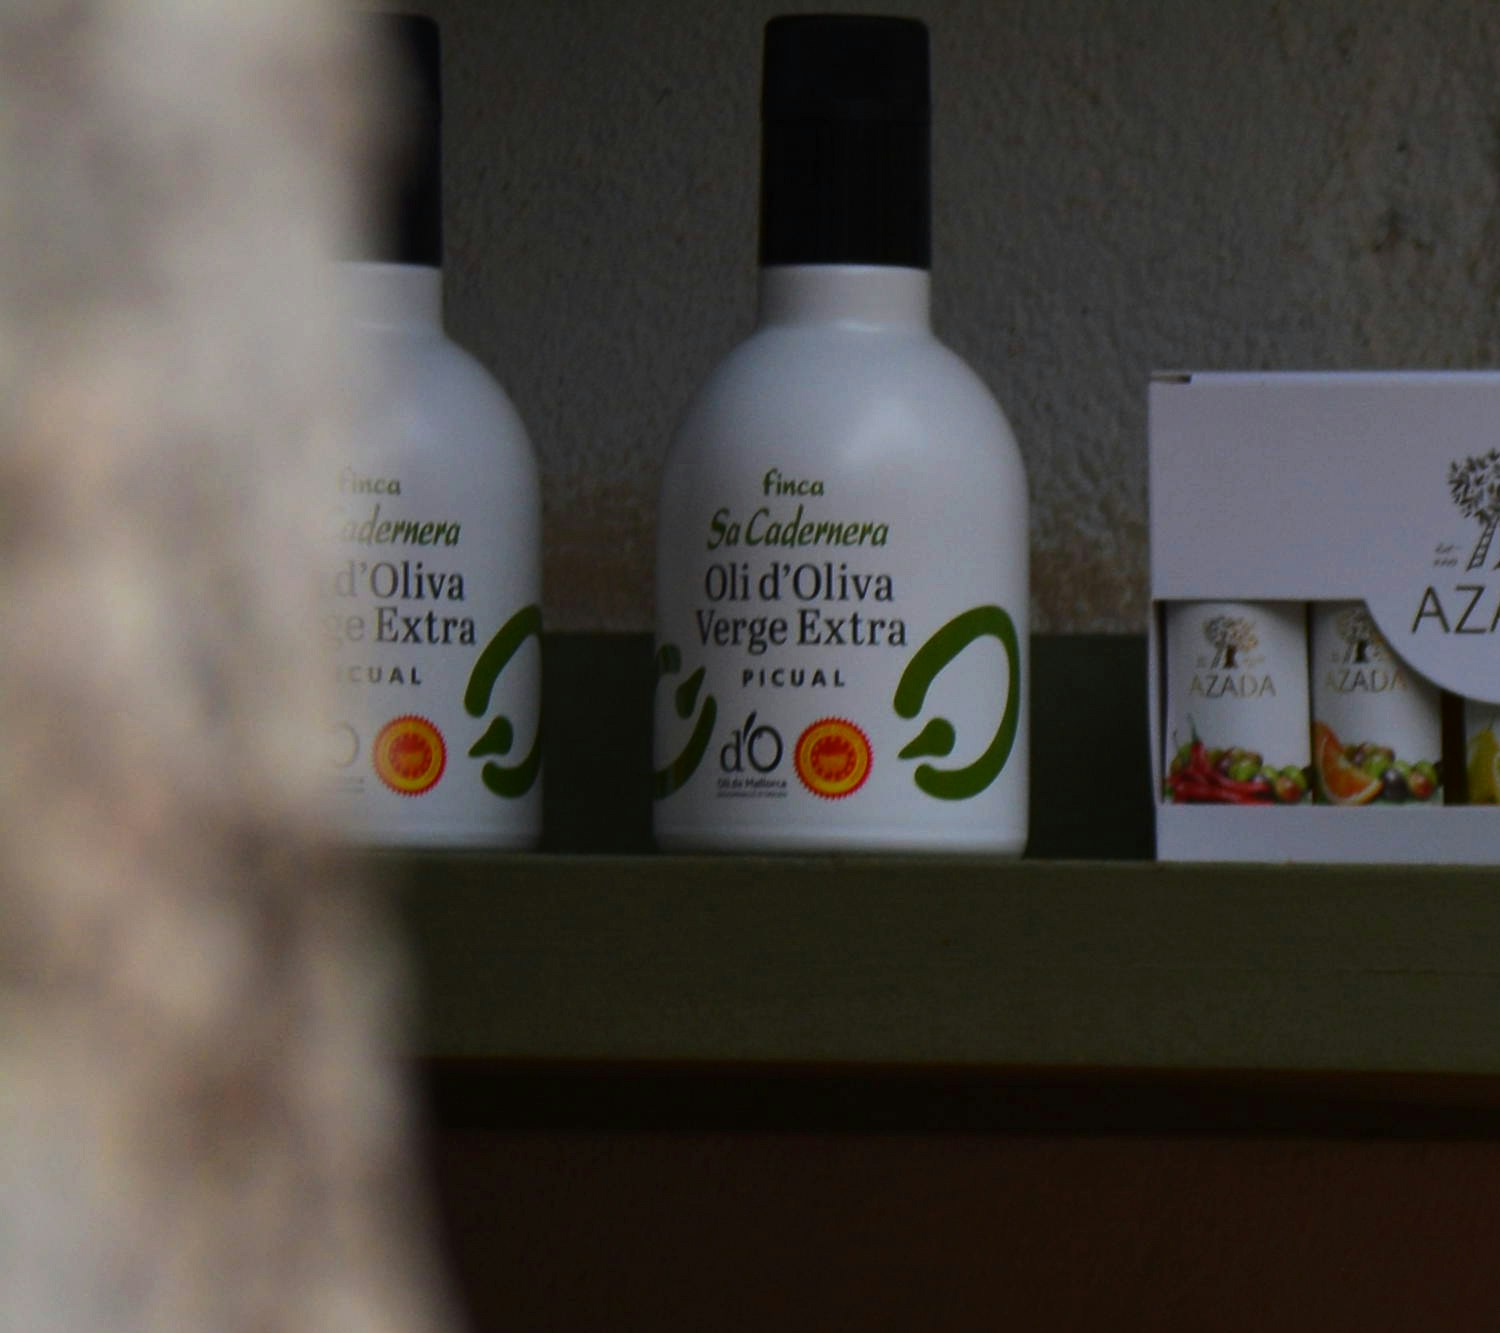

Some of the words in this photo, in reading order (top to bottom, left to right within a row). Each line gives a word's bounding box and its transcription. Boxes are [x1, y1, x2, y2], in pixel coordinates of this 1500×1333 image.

[763, 468, 825, 497] finca
[334, 502, 461, 547] adernera
[707, 507, 742, 551] Sa
[745, 503, 889, 549] Cadernera
[704, 562, 750, 602] Oli
[758, 562, 895, 602] d'Oliva
[375, 605, 477, 647] Extra
[695, 608, 789, 656] Verge
[797, 608, 908, 647] Extra
[336, 664, 422, 687] ICUAL
[741, 668, 846, 690] PICUAL
[1188, 674, 1277, 699] AZADA
